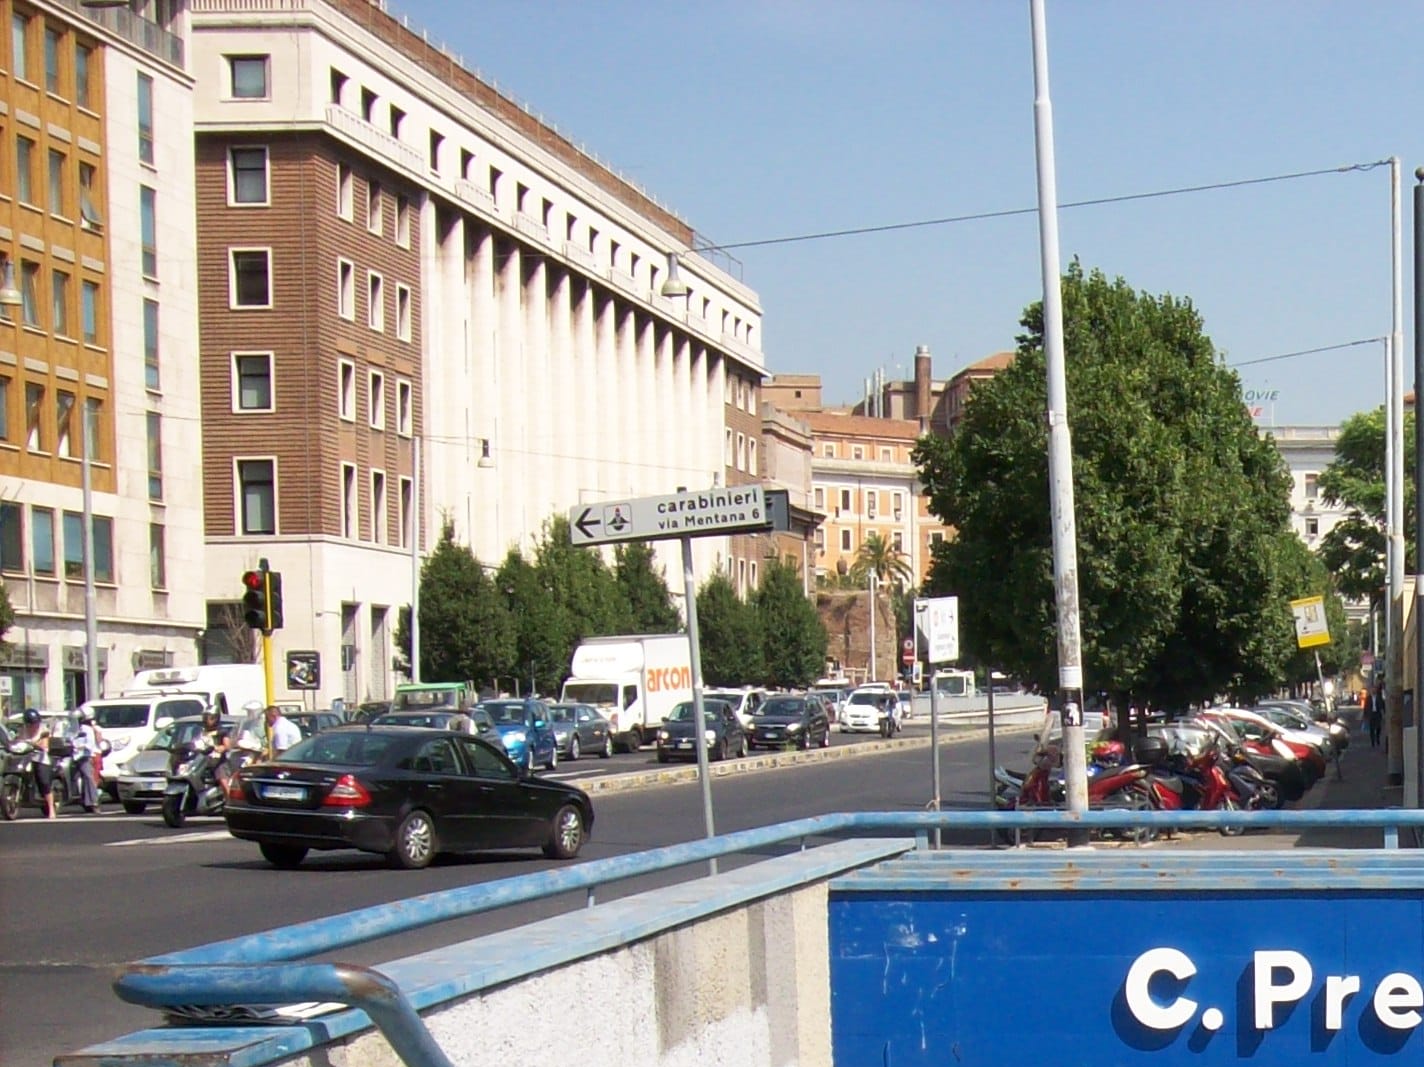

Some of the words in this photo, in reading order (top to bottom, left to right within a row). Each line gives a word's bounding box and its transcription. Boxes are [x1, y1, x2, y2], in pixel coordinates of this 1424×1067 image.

[657, 488, 758, 514] carabinieri
[658, 518, 678, 530] via
[684, 511, 745, 528] Mentana
[751, 508, 760, 519] 6
[647, 666, 691, 692] arcon
[1125, 947, 1224, 1031] C.
